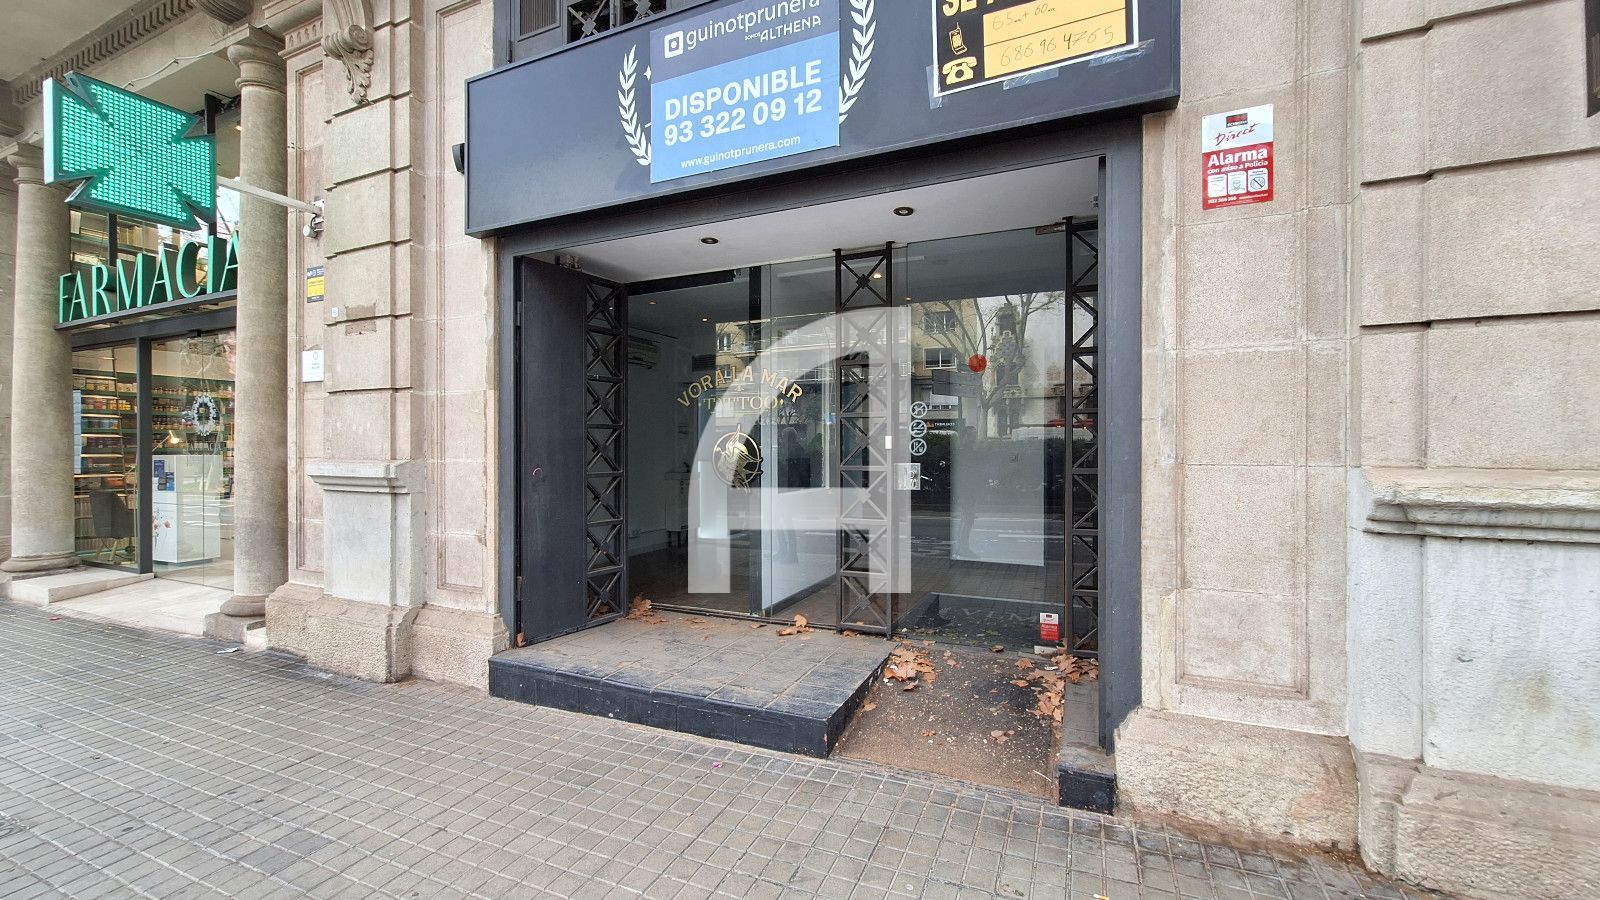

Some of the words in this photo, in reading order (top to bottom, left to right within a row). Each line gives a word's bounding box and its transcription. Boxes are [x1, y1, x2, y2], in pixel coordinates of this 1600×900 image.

[760, 15, 822, 43] ALTHENA
[665, 59, 822, 121] DISPONIBLE
[664, 120, 694, 146] 93
[700, 107, 746, 138] 322
[752, 97, 786, 126] 09
[793, 88, 822, 116] 12
[1213, 122, 1260, 146] Direct
[680, 135, 801, 169] www.guinotprunera.com
[1207, 148, 1268, 168] Alarma
[59, 230, 239, 324] FARMACIA
[761, 368, 803, 403] MAR
